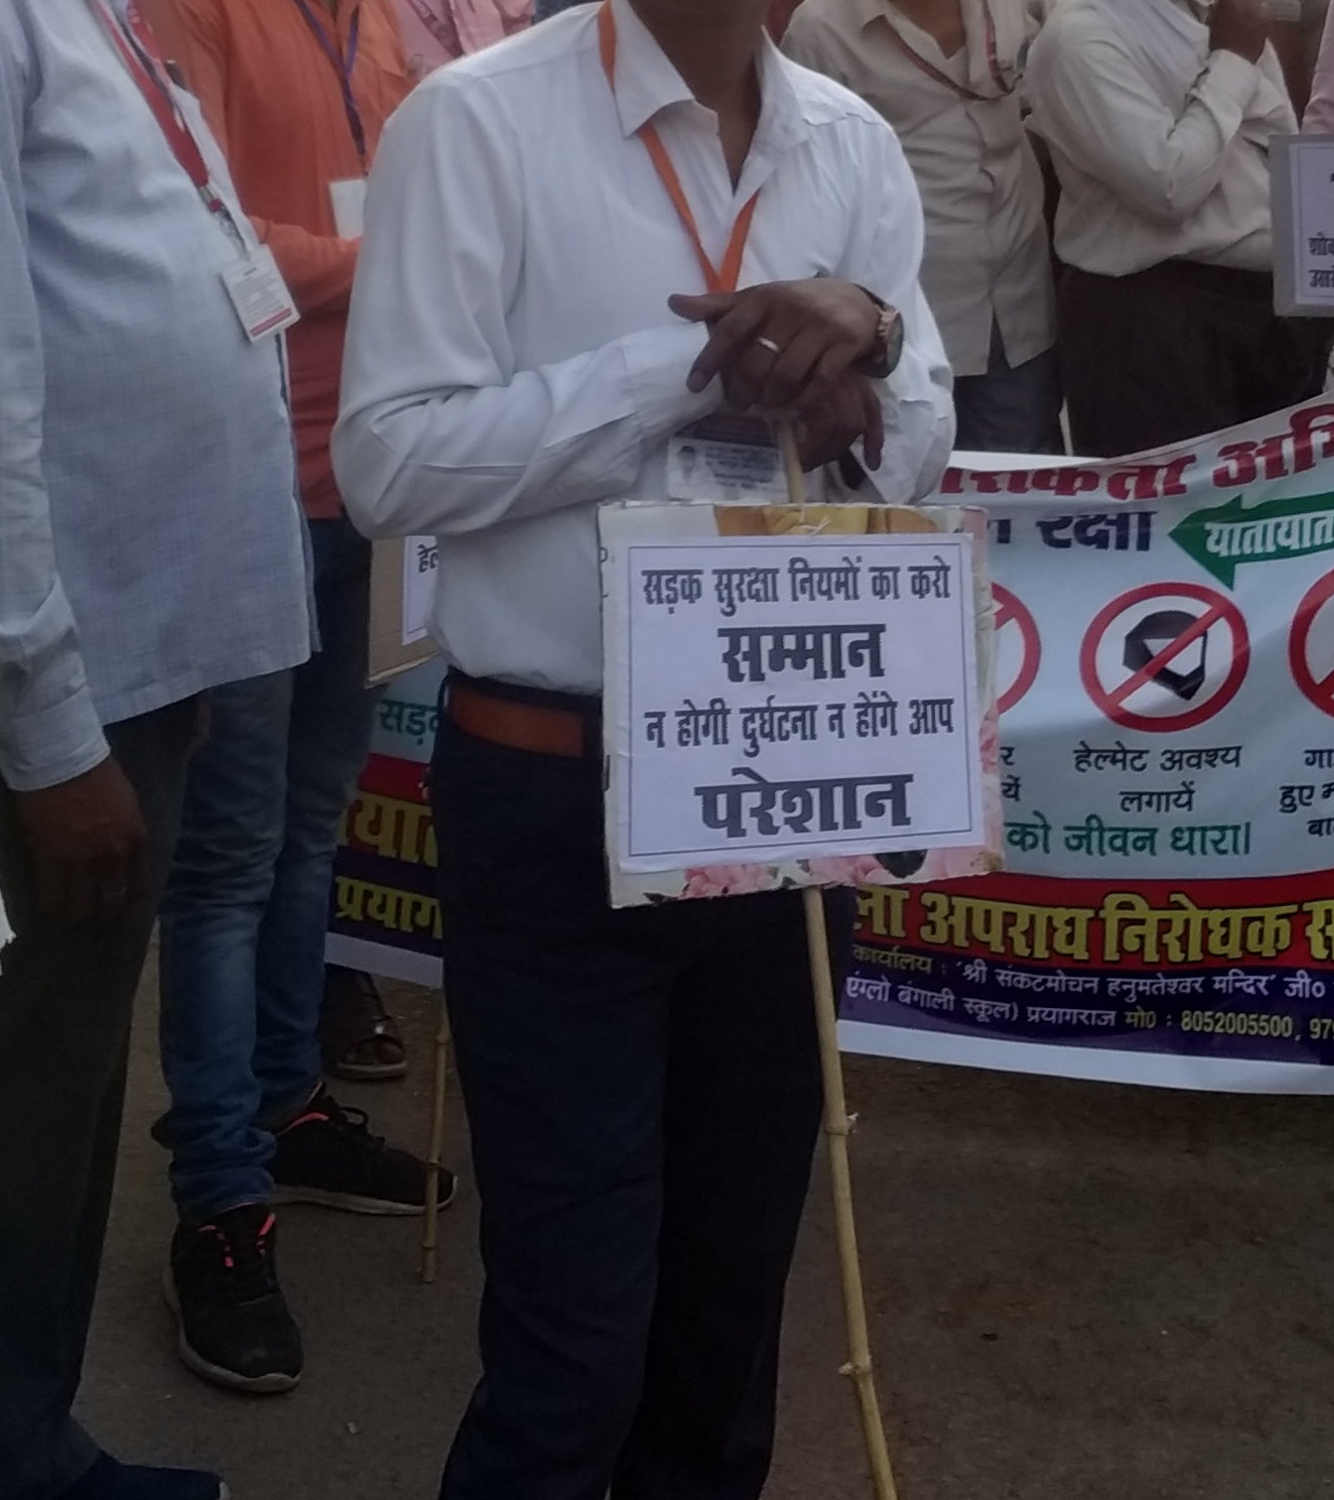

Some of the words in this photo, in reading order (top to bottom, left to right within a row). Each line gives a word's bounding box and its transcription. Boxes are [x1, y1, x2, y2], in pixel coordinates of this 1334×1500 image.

[641, 569, 703, 615] सड़क
[712, 566, 779, 617] सुरक्षा
[788, 556, 862, 602] नियमों
[869, 566, 901, 600] का
[908, 555, 951, 599] करो
[717, 623, 886, 682] सम्मान
[644, 711, 666, 749] न
[675, 697, 732, 747] होगी
[739, 695, 817, 757] दुर्घटना
[826, 703, 846, 739] न
[853, 690, 898, 738] होंगे
[908, 698, 954, 735] आप
[1159, 745, 1243, 772] अवश्य
[694, 766, 914, 839] परेशान
[1118, 781, 1196, 813] लगायें
[1279, 784, 1316, 813] हुए
[1004, 810, 1052, 854] को
[1063, 814, 1159, 857] जीवन
[920, 891, 1095, 961] अपराध
[1100, 892, 1299, 963] निरोधक
[995, 964, 1100, 995] संकटमोचन
[897, 980, 955, 1011] बंगाली
[1026, 1006, 1117, 1028] प्रयागराज
